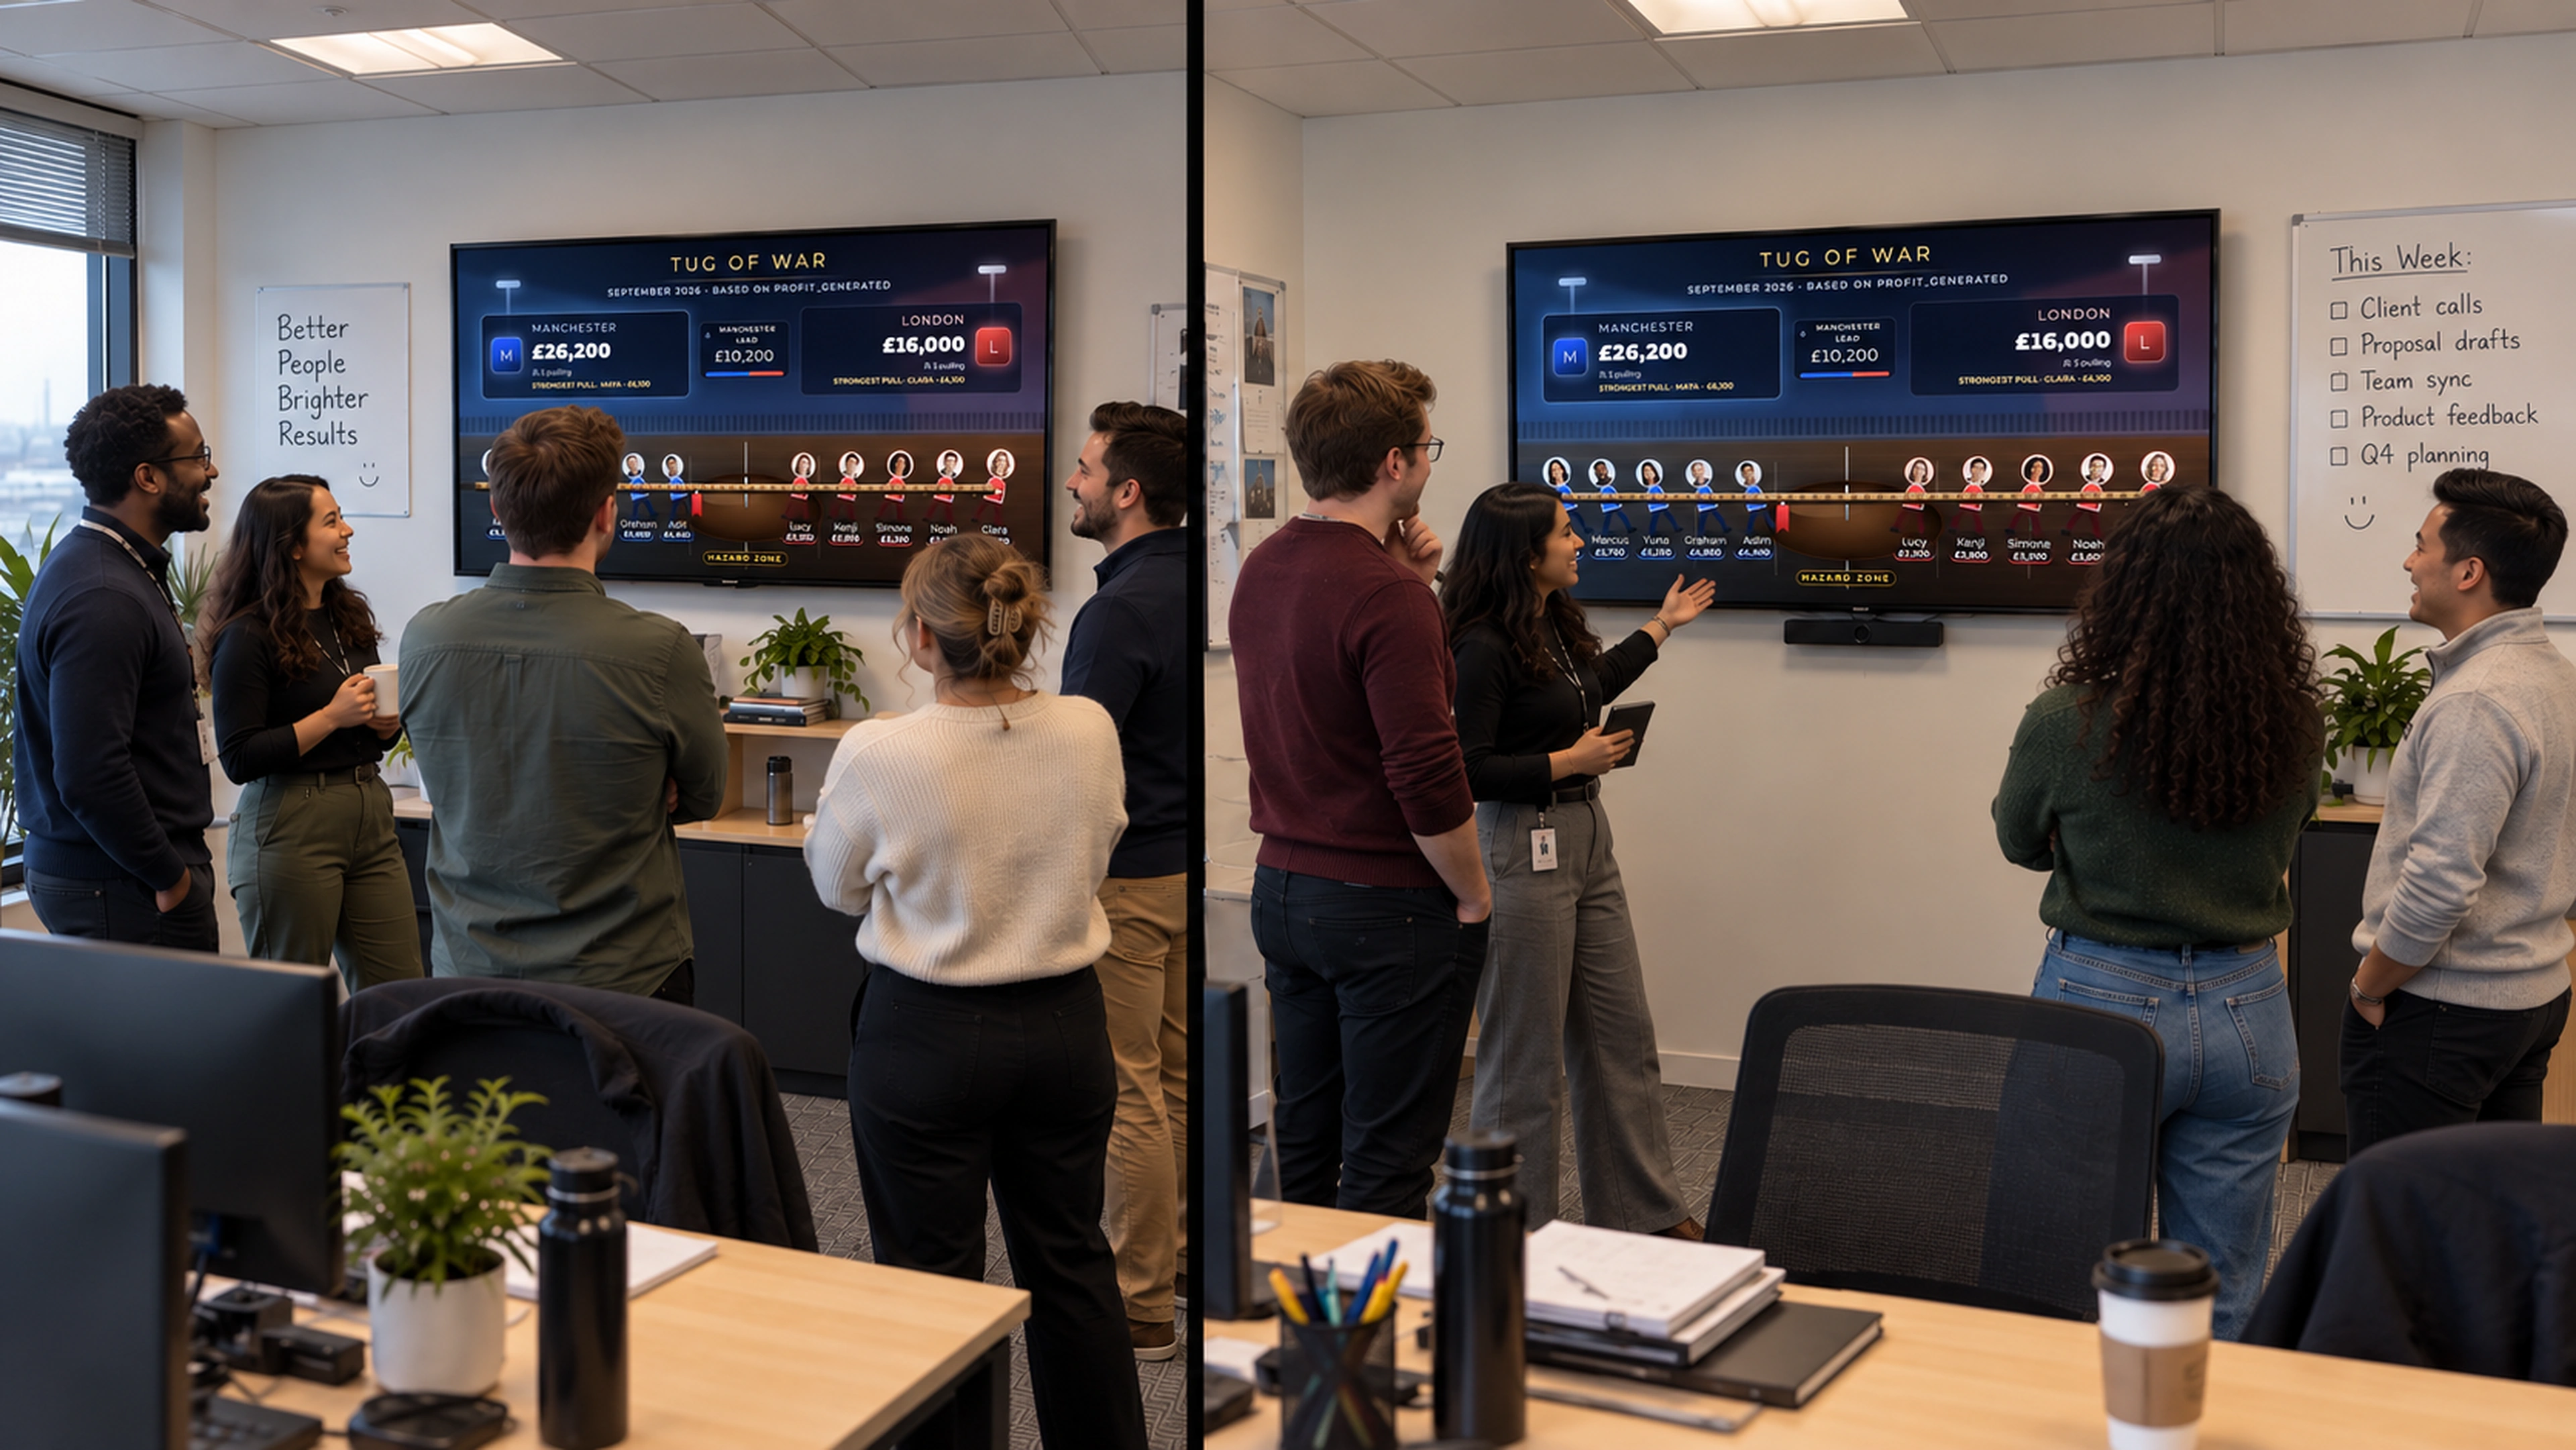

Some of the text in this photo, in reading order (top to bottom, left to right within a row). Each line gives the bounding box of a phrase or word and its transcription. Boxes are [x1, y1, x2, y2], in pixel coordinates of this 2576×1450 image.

[670, 252, 825, 272] TUG OF WAR
[1760, 246, 1930, 267] TUG OF WAR
[2330, 242, 2472, 273] This Week:
[607, 280, 891, 298] SEPTEMBER 2026 BASED ON PROFIT_GENERATED
[1687, 274, 2008, 295] SEPTEMBER 2026 BASED ON PROFIT_GENERATED
[2360, 293, 2483, 319] Client calls
[902, 314, 964, 326] LONDON
[2038, 308, 2110, 321] LONDON
[277, 313, 349, 341] Better
[532, 323, 616, 333] MANCHESTER
[1599, 321, 1693, 333] MANCHESTER
[1816, 323, 1880, 331] MANCHESTER
[883, 336, 965, 356] £16,000
[989, 340, 999, 354] L
[2015, 331, 2111, 352] £16,000
[2141, 335, 2149, 350] L
[2361, 328, 2521, 360] Proposal drafts
[500, 350, 513, 362] M
[532, 343, 611, 362] £26,200
[715, 349, 774, 364] £10,200
[1563, 351, 1577, 364] M
[1598, 343, 1687, 363] £26,200
[1811, 348, 1878, 363] £10,200
[278, 349, 346, 382] People
[2360, 370, 2473, 396] Team sync
[278, 384, 368, 420] Brighter
[2361, 403, 2540, 428] Product feedback
[278, 420, 358, 446] Results
[2361, 442, 2489, 473] Q4 planning
[930, 524, 957, 534] Noah
[1591, 535, 1629, 544] Marcus
[1902, 537, 1927, 548] Lucy
[2007, 538, 2051, 549] Simone
[2073, 539, 2104, 550] Noah
[754, 554, 782, 563] ZONE
[1801, 574, 1889, 582] HAZARD ZONE
